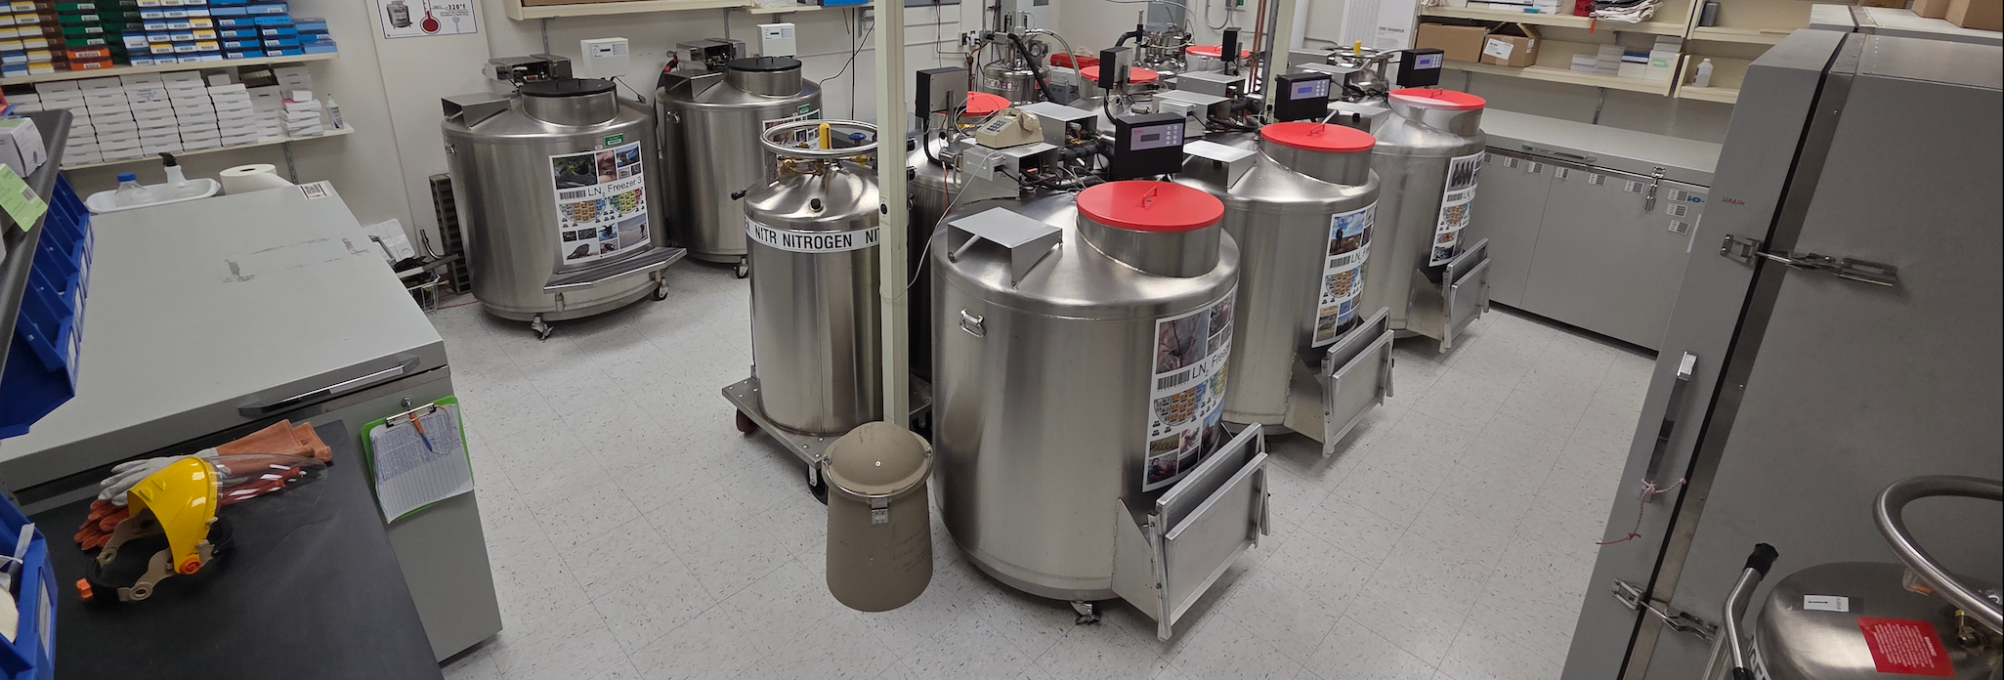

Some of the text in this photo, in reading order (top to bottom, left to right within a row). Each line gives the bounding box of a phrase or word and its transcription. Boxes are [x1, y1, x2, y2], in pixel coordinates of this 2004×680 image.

[607, 179, 636, 193] Freezer
[637, 176, 642, 185] 3
[754, 224, 777, 245] NITR
[782, 233, 852, 249] NITROGEN
